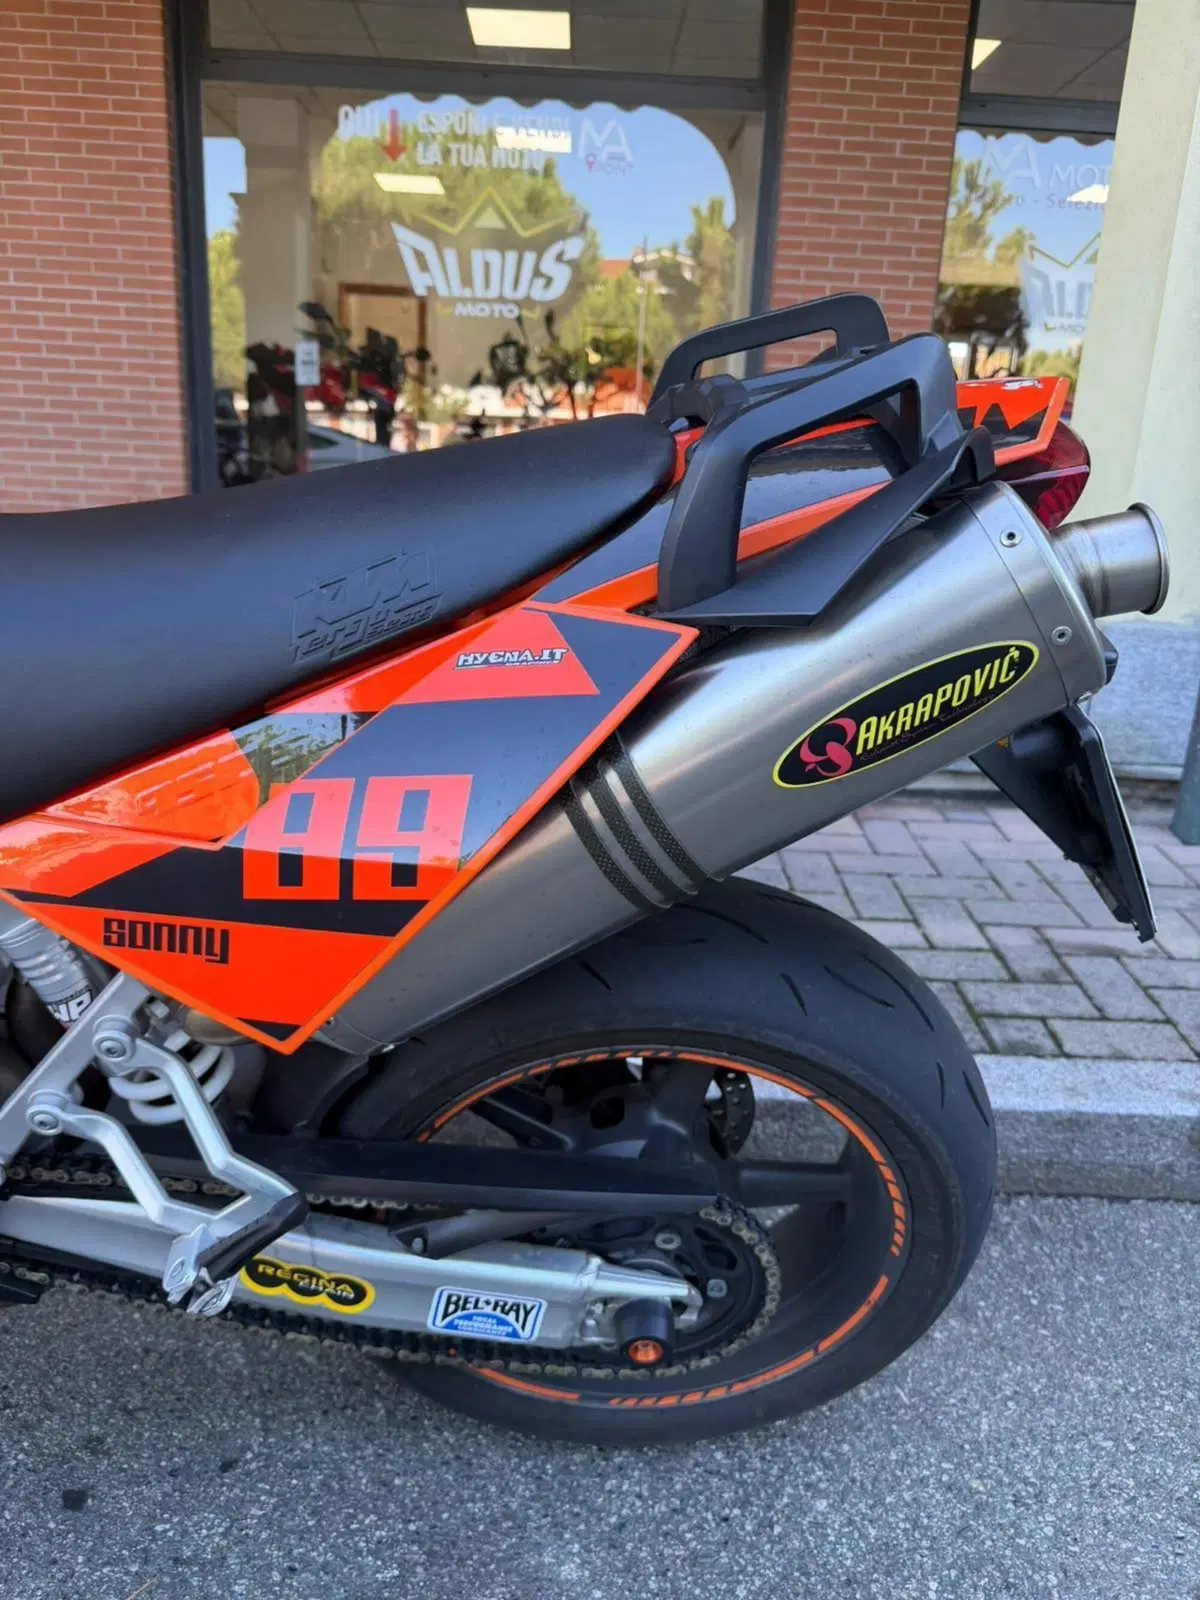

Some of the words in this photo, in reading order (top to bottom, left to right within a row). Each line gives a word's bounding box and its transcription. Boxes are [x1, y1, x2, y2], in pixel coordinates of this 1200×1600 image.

[416, 141, 443, 166] LA
[448, 143, 489, 169] TUA
[1048, 164, 1111, 190] MOT
[391, 222, 586, 302] ALDUS
[454, 302, 520, 319] MOTO
[457, 648, 568, 666] HYENA.IT
[243, 774, 474, 901] 89
[257, 1263, 354, 1295] REGINA
